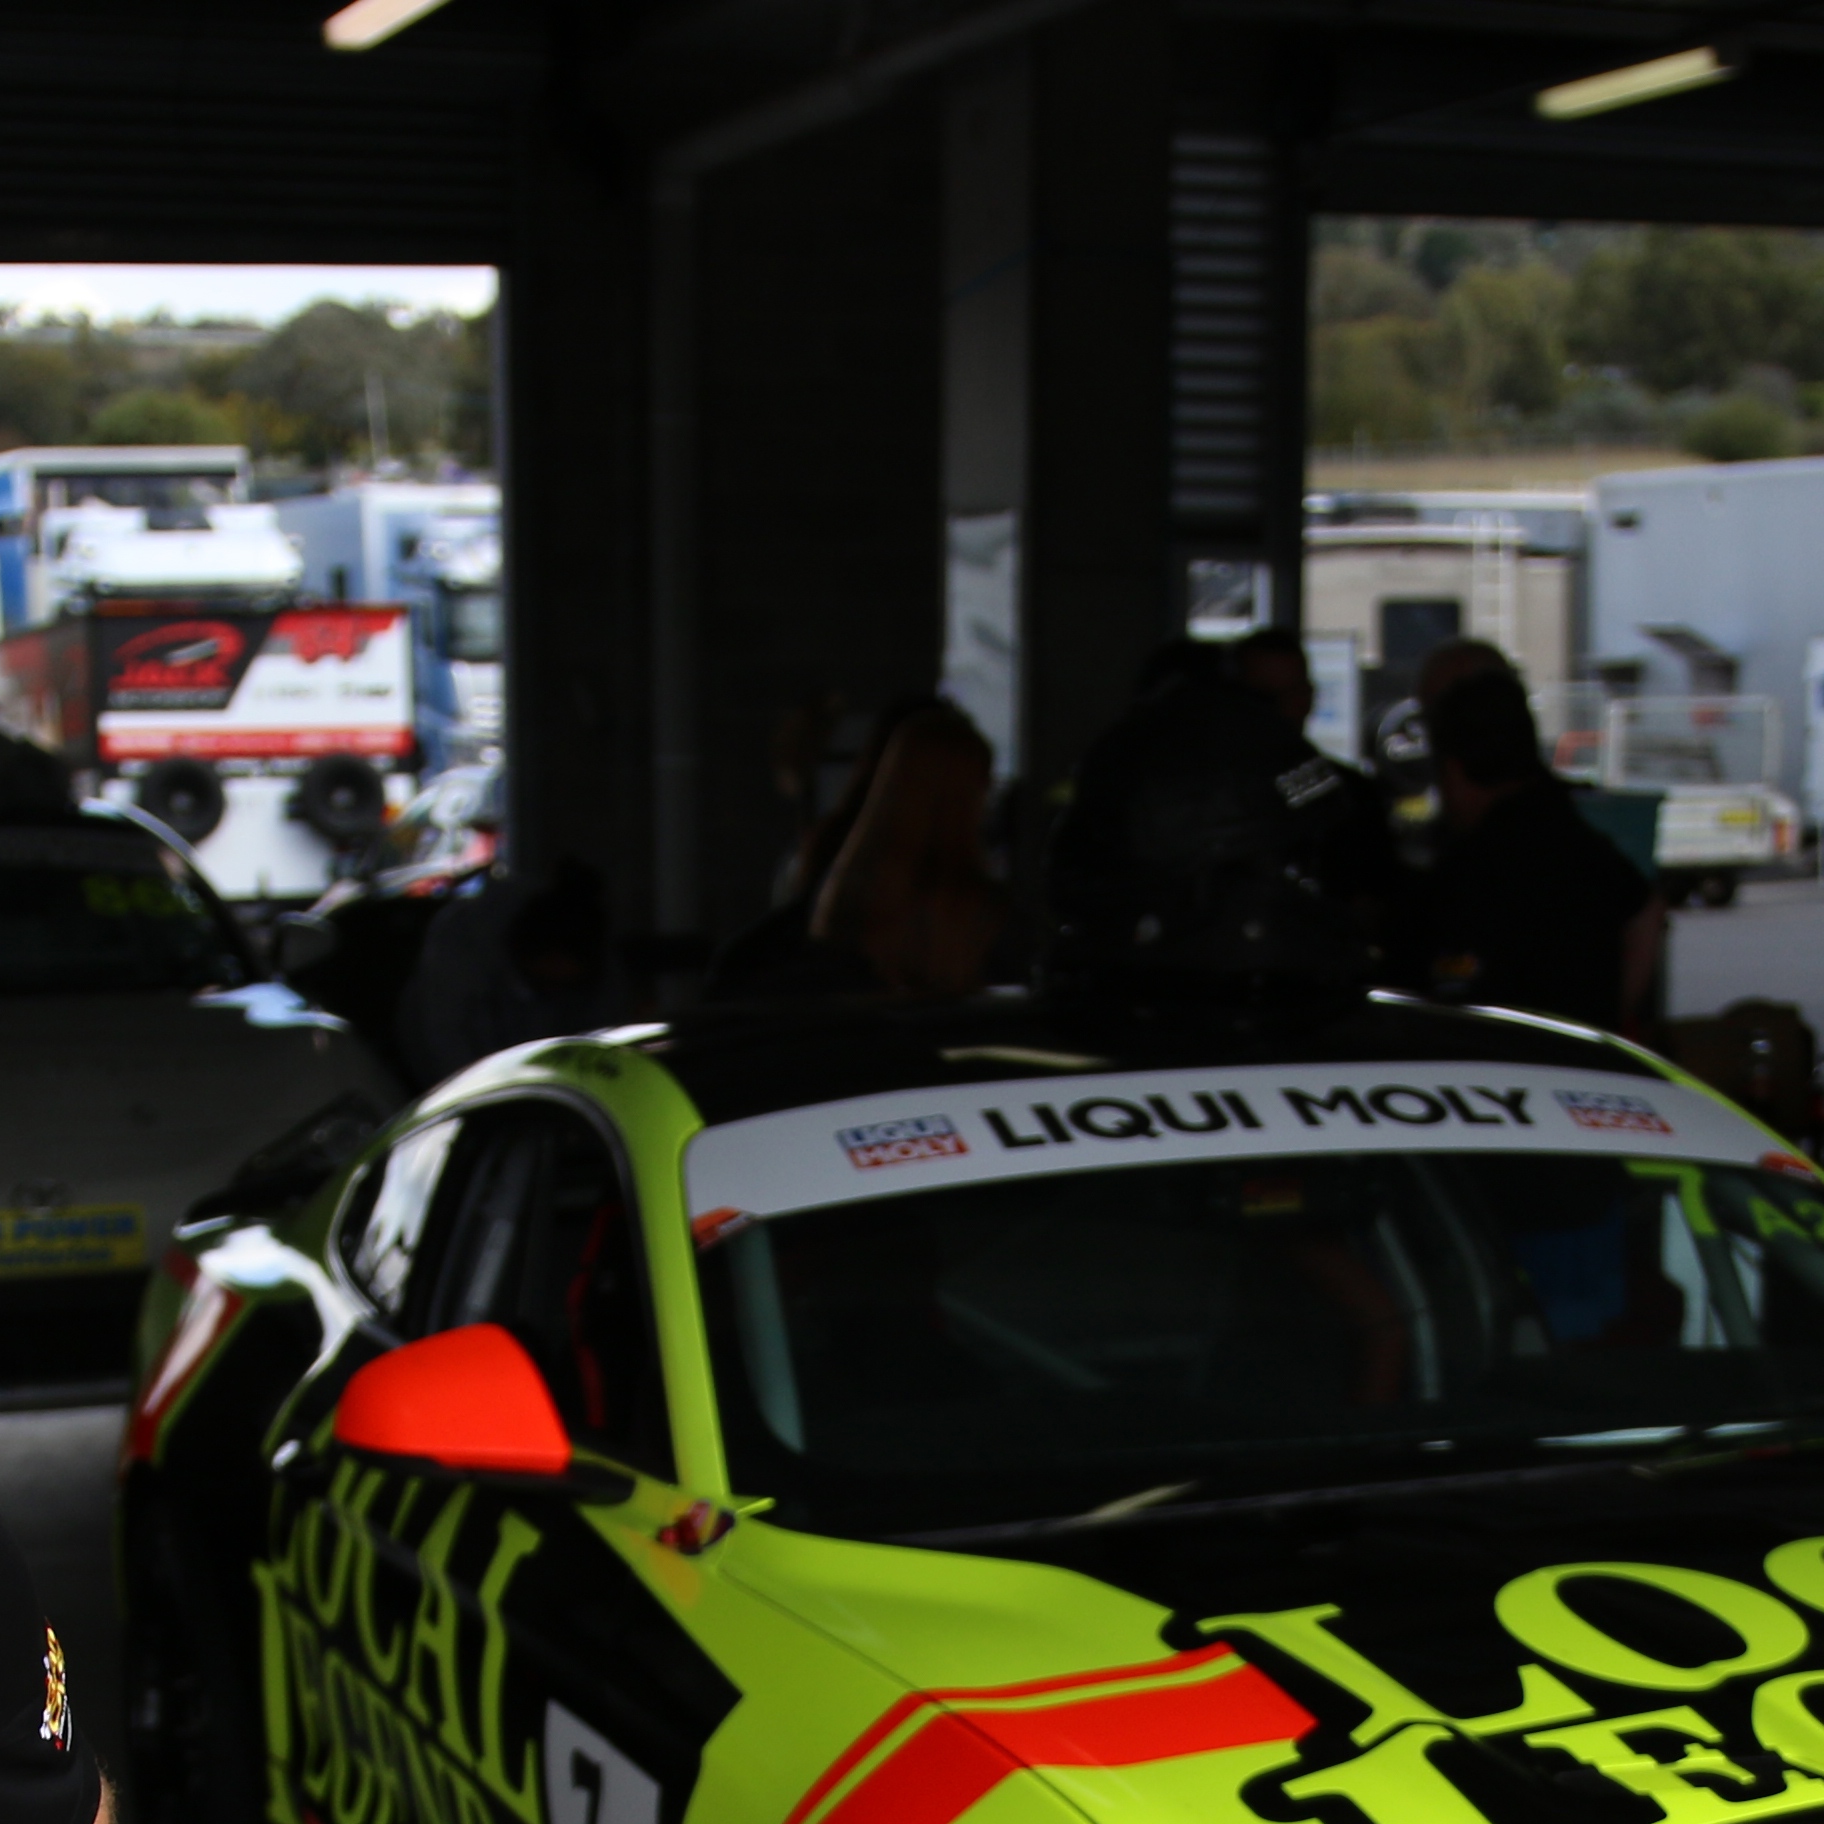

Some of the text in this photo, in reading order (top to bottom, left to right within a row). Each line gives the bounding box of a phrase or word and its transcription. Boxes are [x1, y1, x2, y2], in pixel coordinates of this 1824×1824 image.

[984, 1084, 1534, 1148] LIQUI MOLY
[1622, 1156, 1720, 1238] 7
